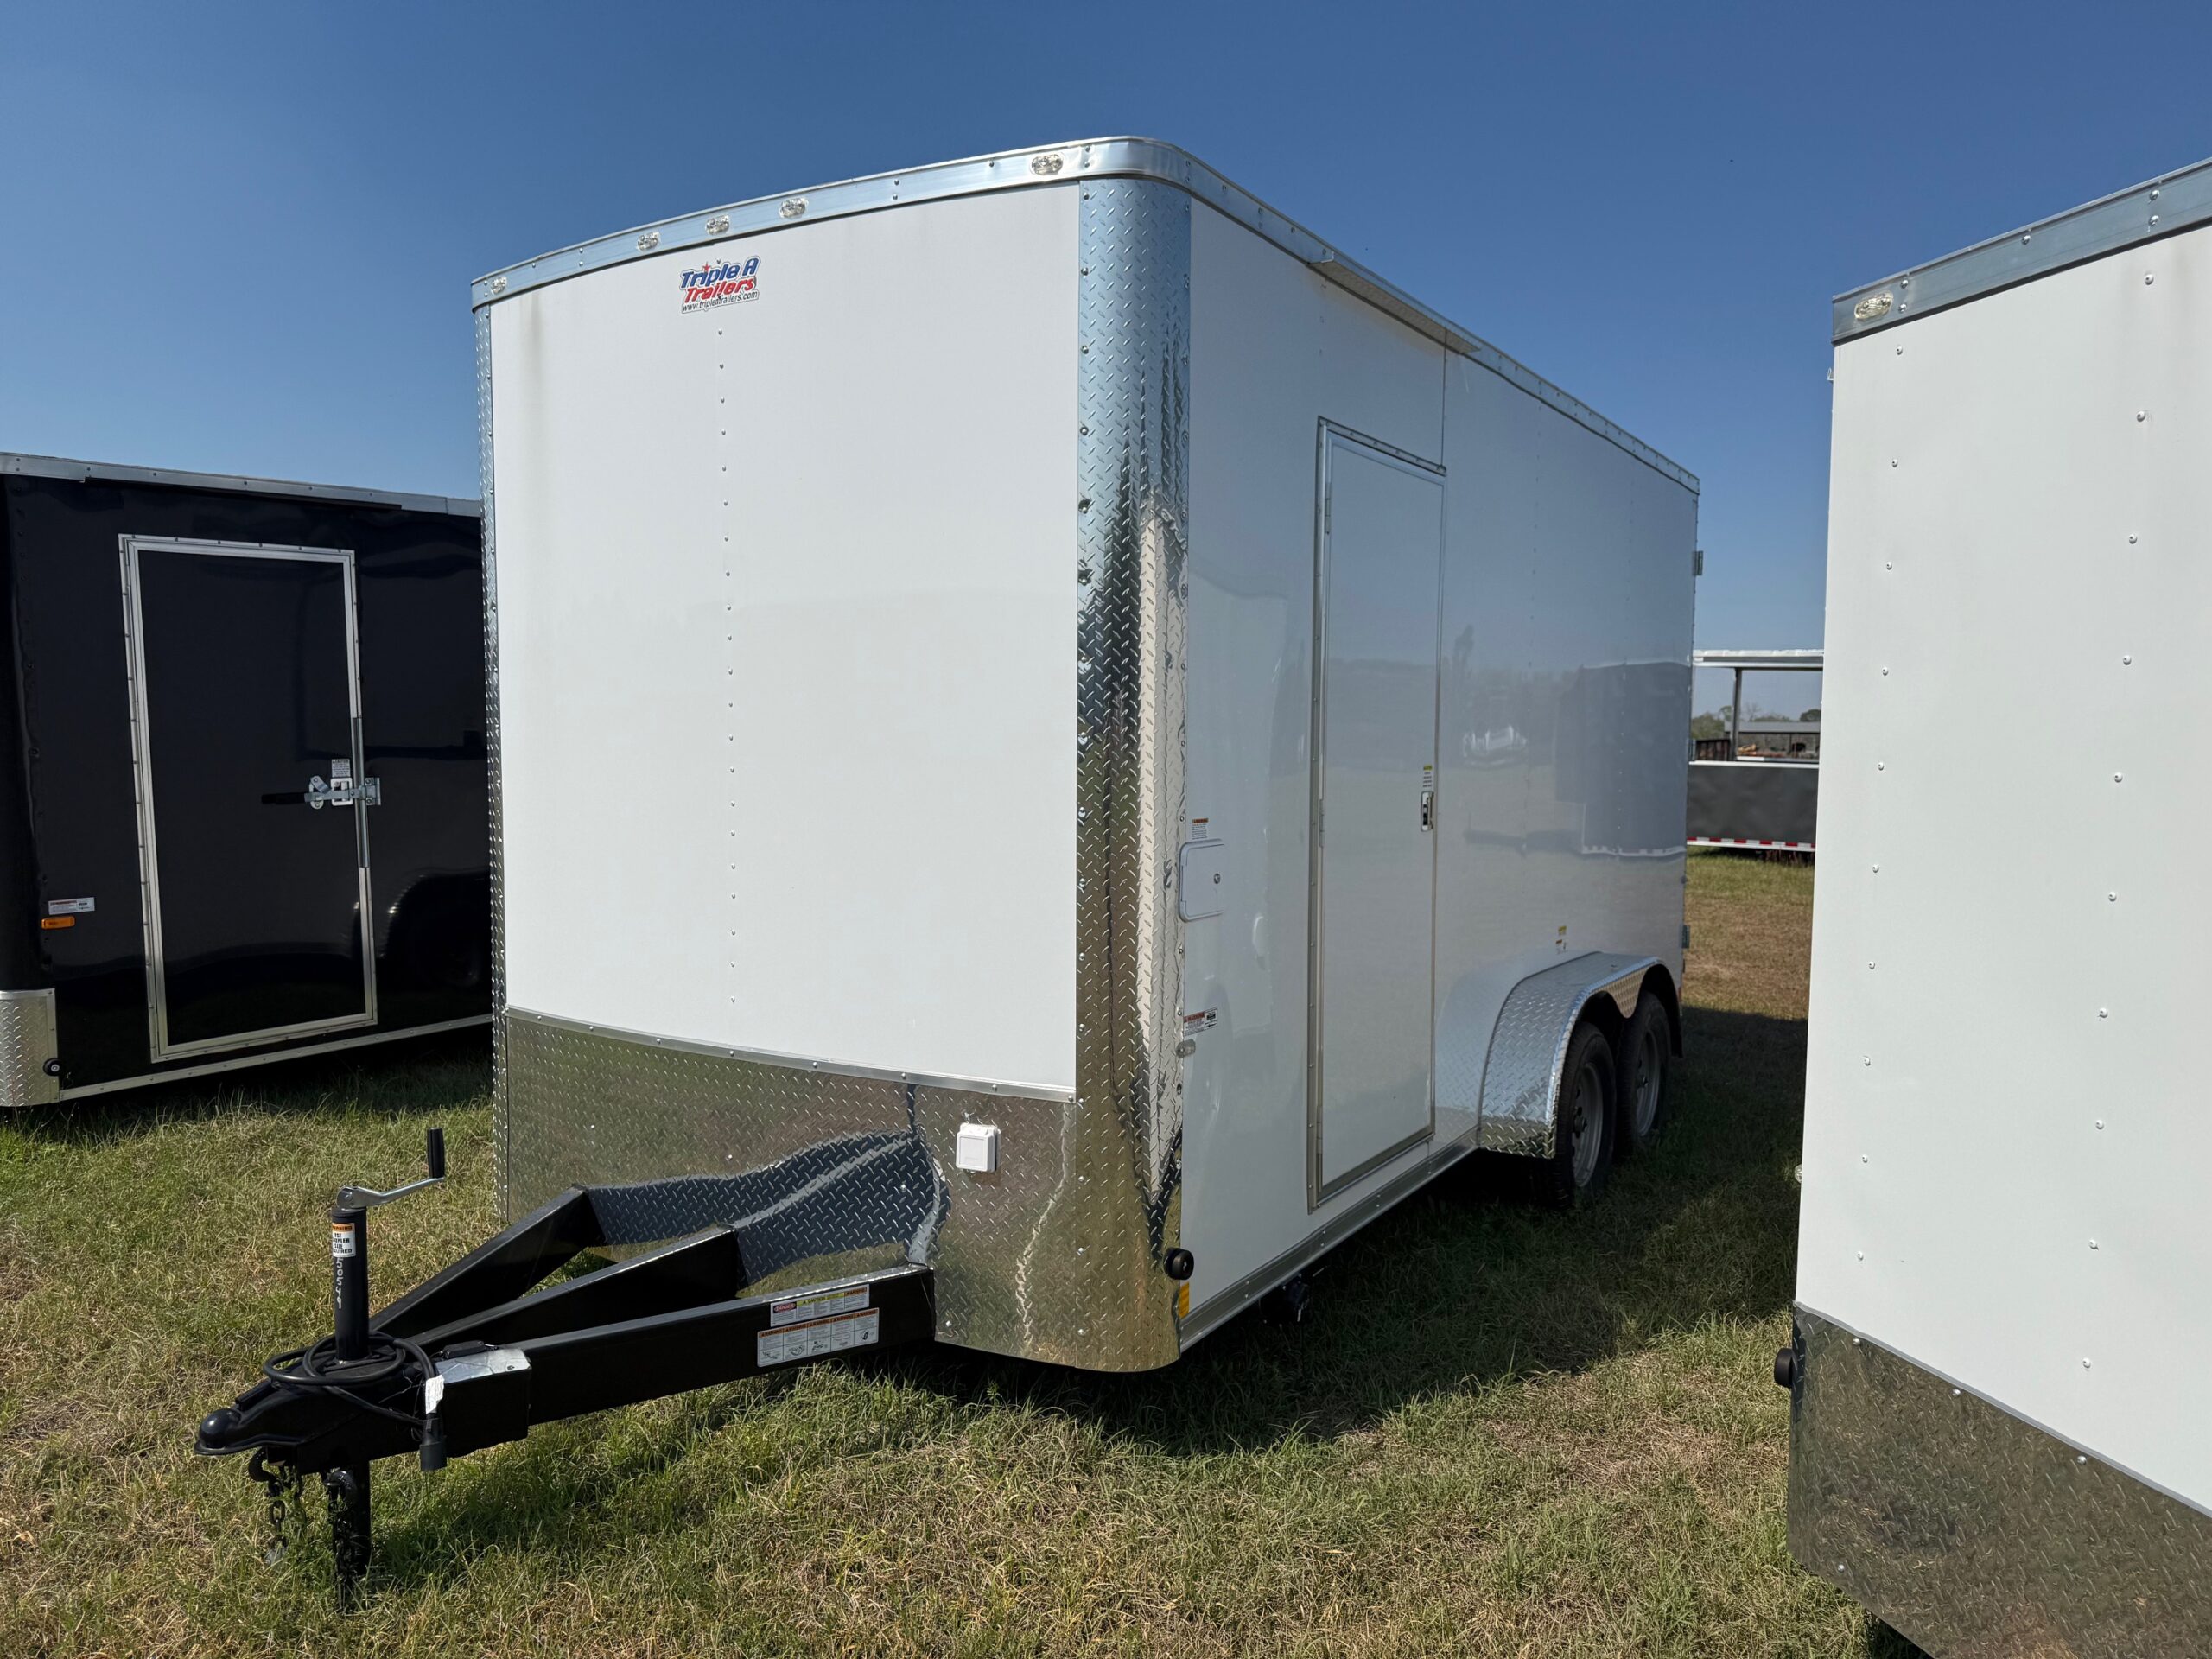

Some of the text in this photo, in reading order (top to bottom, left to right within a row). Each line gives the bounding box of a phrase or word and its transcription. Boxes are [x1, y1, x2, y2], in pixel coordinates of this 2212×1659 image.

[681, 257, 760, 289] Triple A
[684, 278, 753, 303] Trailers
